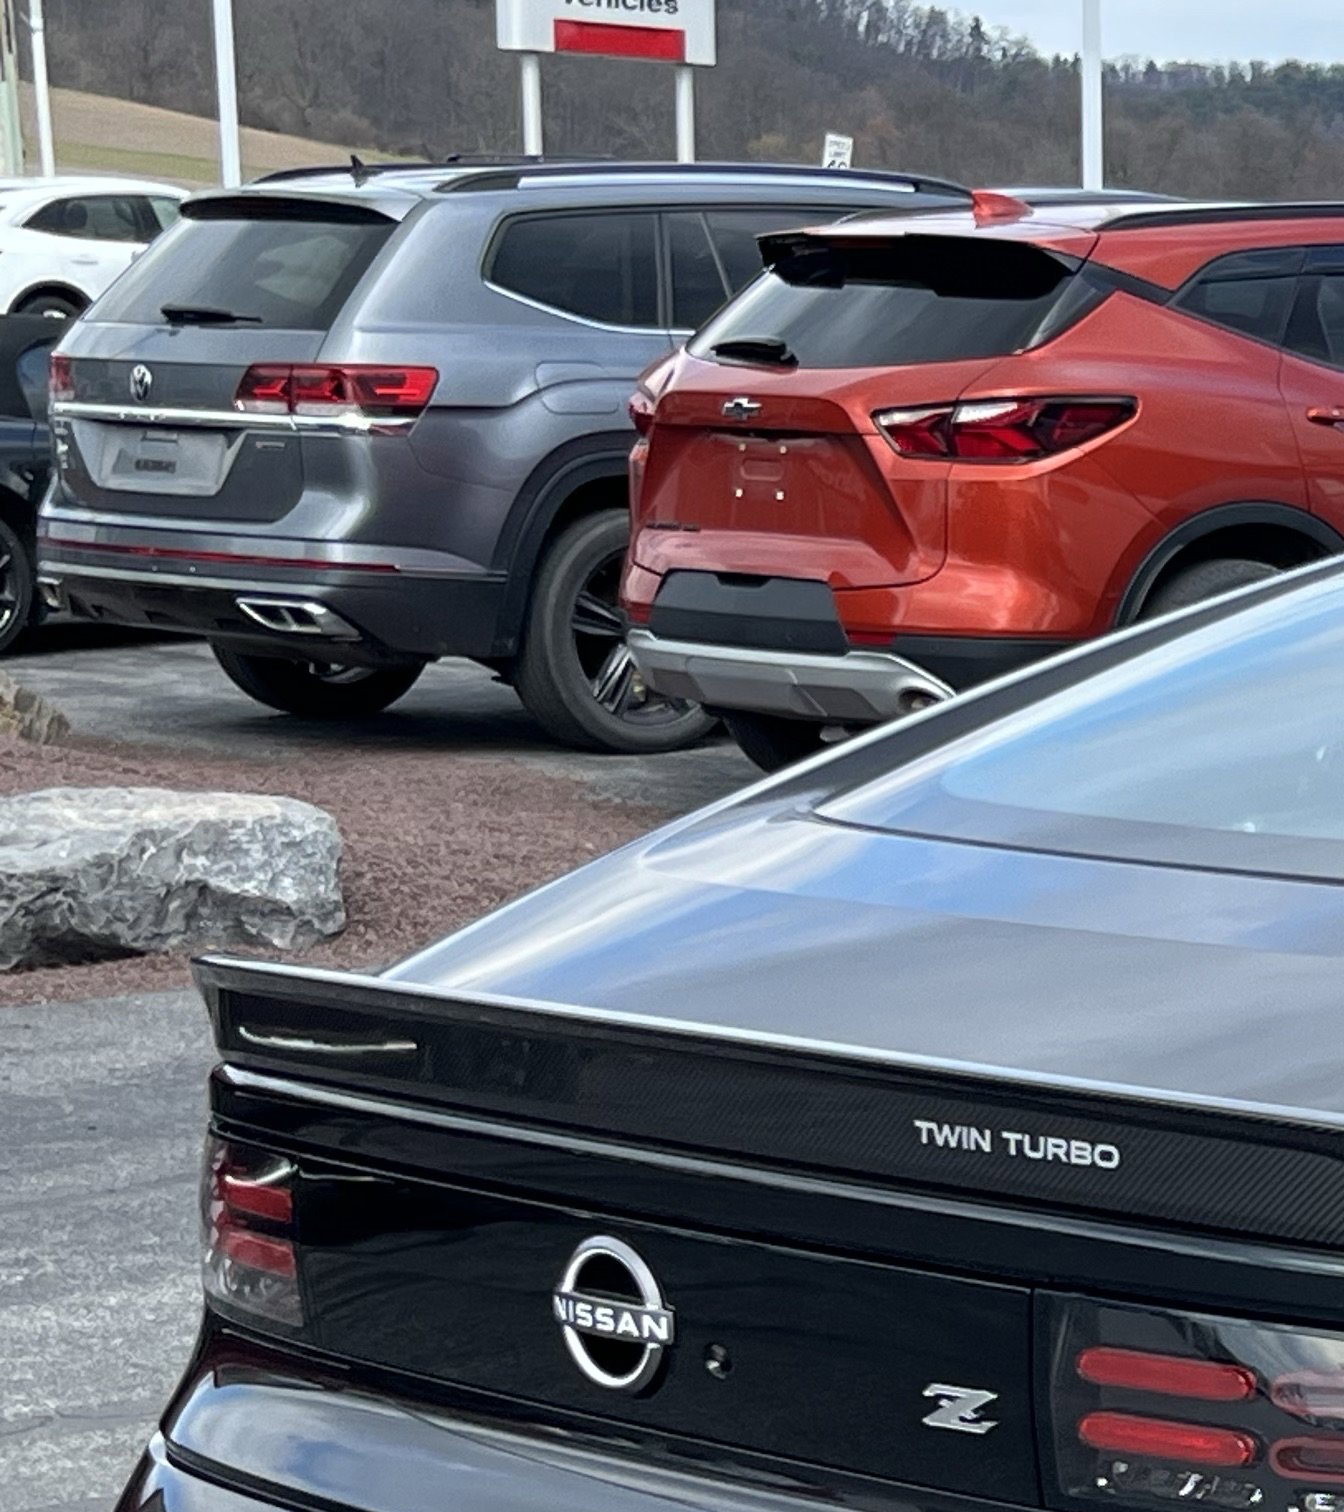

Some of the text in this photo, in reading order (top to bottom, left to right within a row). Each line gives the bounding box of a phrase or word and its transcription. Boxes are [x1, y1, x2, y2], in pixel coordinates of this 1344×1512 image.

[565, 0, 679, 15] cles
[913, 1119, 1120, 1169] TWIN TURBO
[553, 1294, 669, 1340] NISSAN
[922, 1383, 999, 1434] Z
